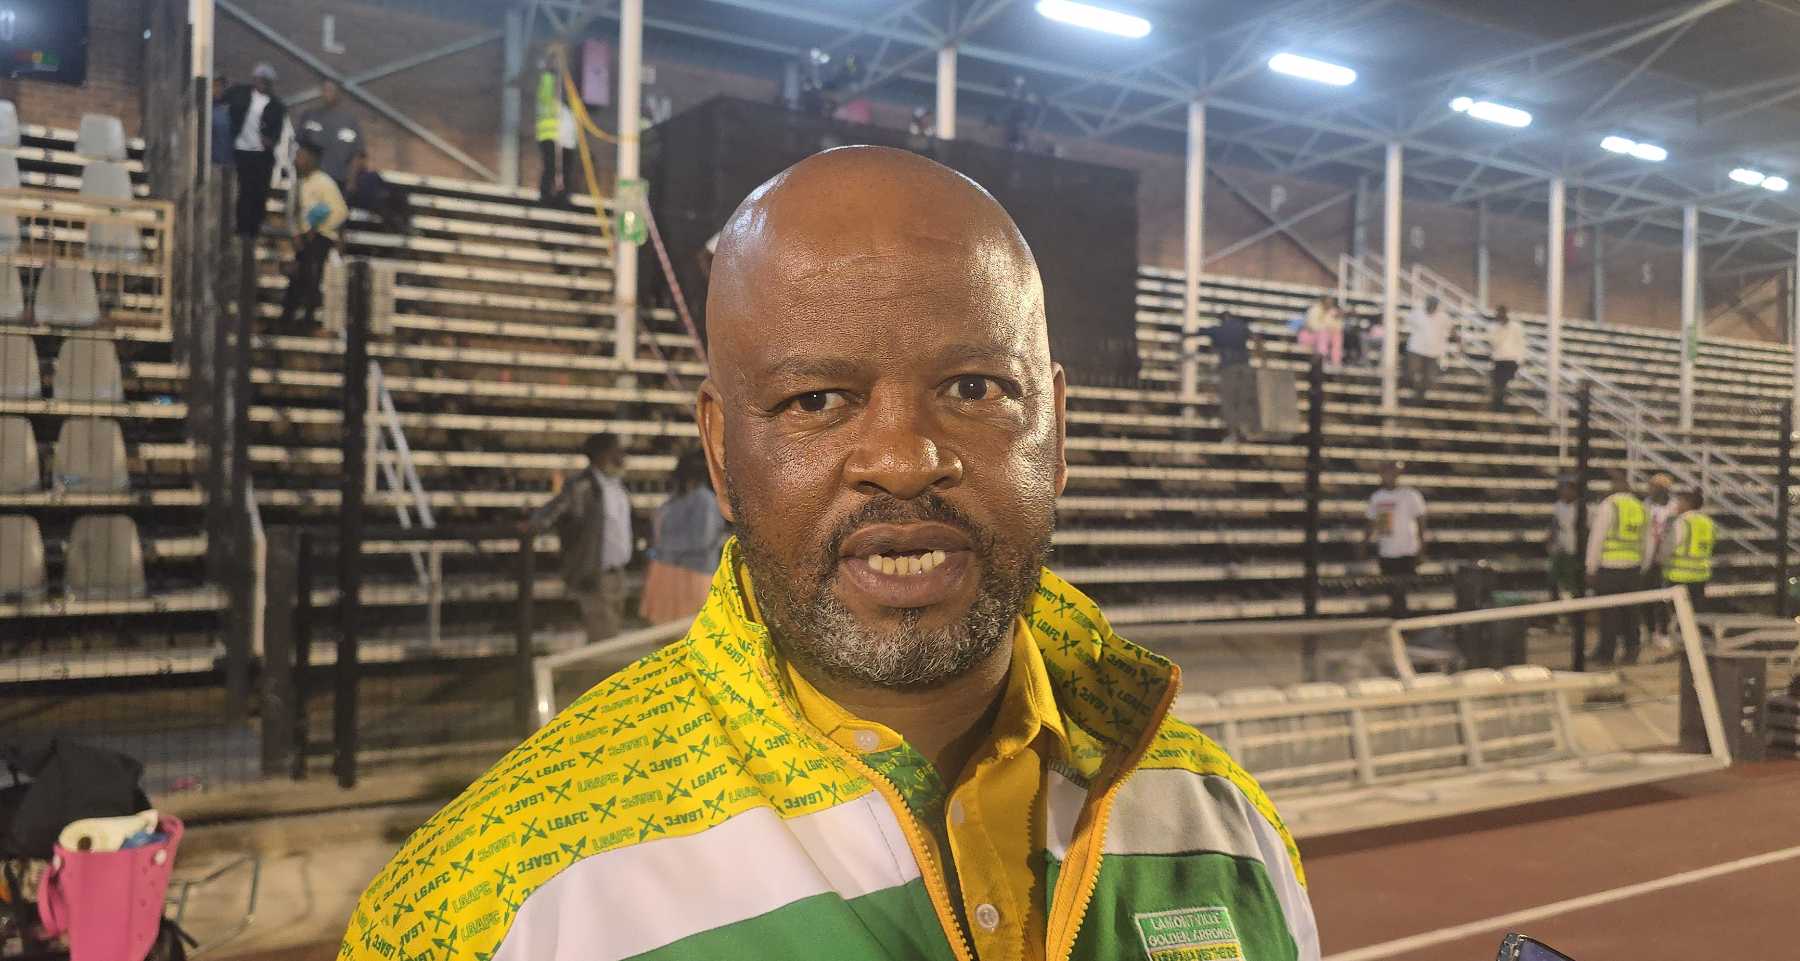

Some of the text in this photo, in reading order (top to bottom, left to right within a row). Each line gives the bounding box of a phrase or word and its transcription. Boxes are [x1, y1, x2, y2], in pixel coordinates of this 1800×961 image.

[322, 14, 346, 54] L
[637, 702, 675, 722] LGAFC
[677, 712, 713, 737] LGAFC
[536, 758, 577, 778] LGAFC
[649, 753, 690, 773] LGAFC
[691, 763, 728, 790] LGAFC
[504, 792, 545, 815] LGAFC
[783, 790, 824, 809] LGAFC
[547, 811, 590, 832] LGAFC
[664, 808, 704, 827] LGAFC
[517, 850, 561, 875] LGAFC
[413, 871, 452, 903] LGAFC
[1148, 927, 1233, 946] GOLDEN ARROWS
